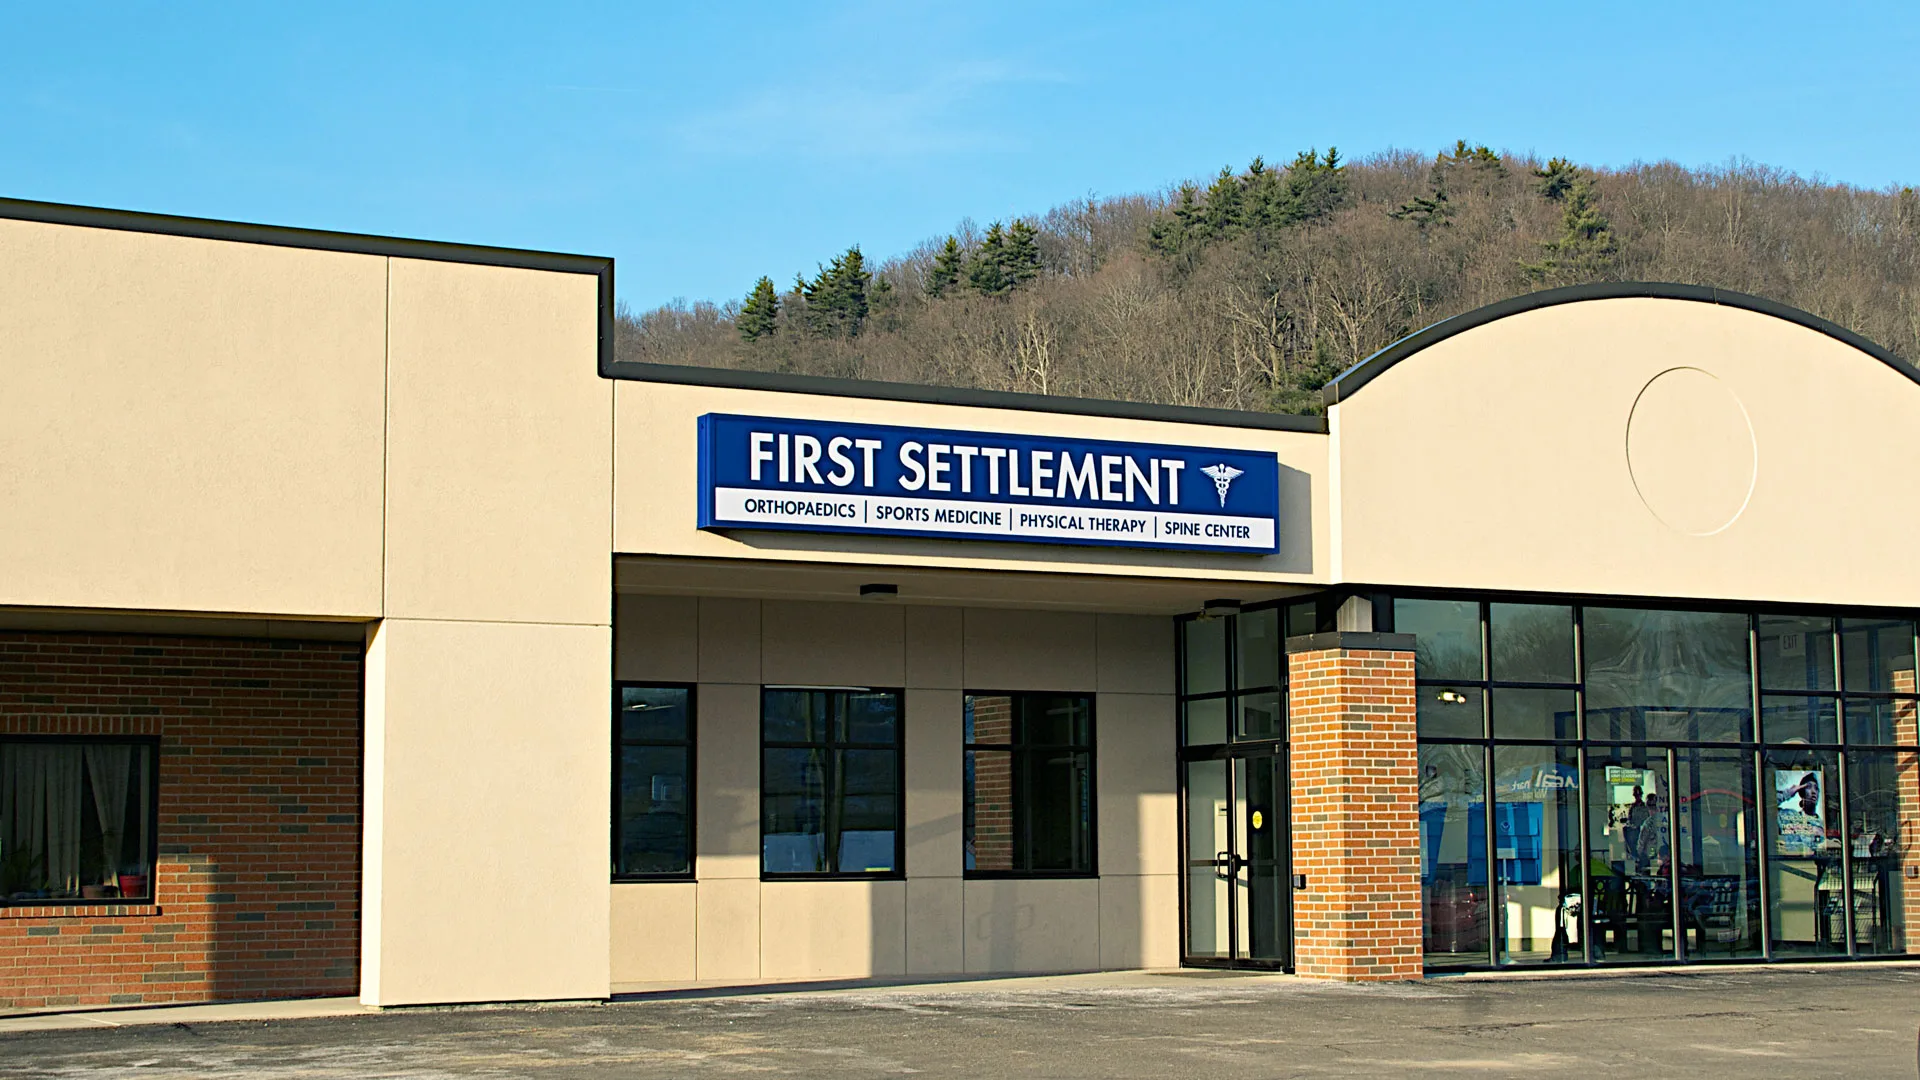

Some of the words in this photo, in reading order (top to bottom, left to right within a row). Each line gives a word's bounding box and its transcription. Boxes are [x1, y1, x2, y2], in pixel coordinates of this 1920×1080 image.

[749, 431, 882, 487] FIRST
[898, 440, 1186, 506] SETTLEMENT
[744, 498, 856, 519] ORTHOPAEDICS
[876, 505, 930, 522] SPORTS
[934, 508, 1002, 526] MEDICINE
[1020, 513, 1085, 530] PHYSICAL
[1088, 517, 1147, 533] THERAPY
[1165, 521, 1201, 536] SPINE
[1204, 523, 1250, 539] CENTER
